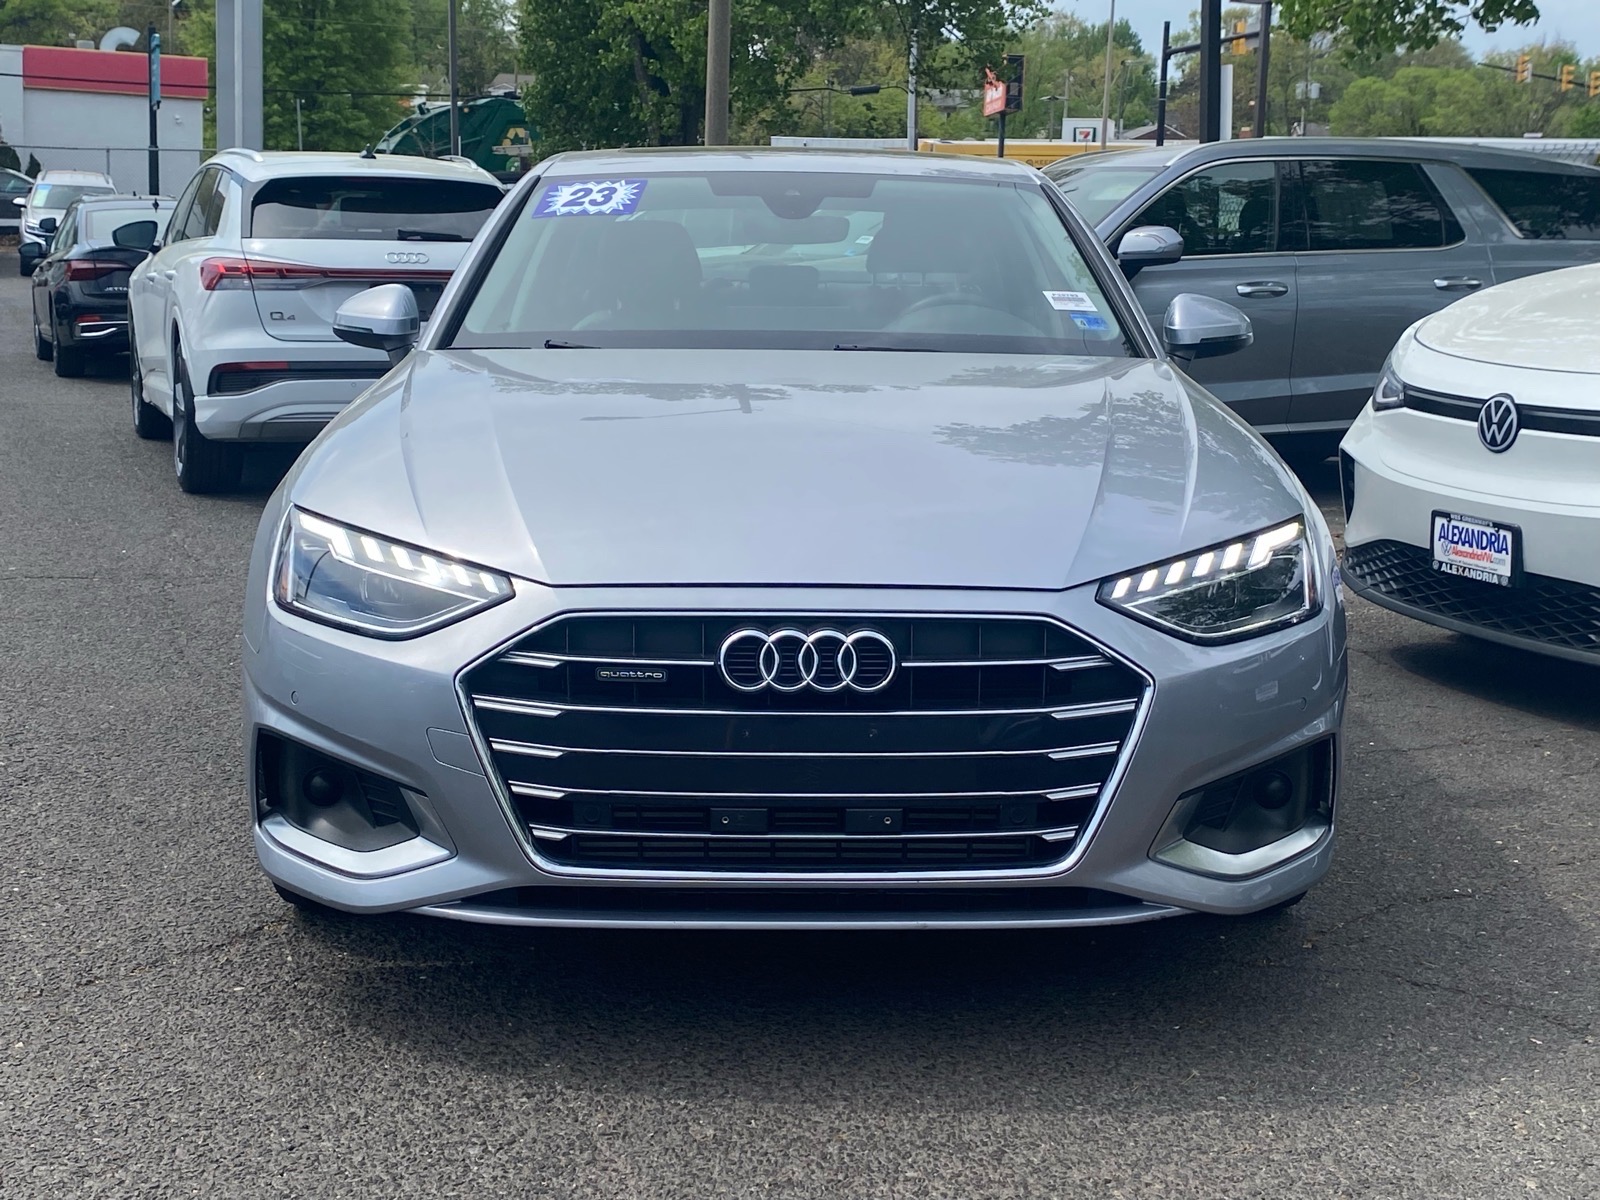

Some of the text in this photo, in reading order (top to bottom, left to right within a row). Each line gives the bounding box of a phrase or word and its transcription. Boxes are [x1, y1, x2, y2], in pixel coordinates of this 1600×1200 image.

[560, 186, 618, 207] 23
[270, 311, 296, 321] Q4
[1438, 522, 1509, 555] ALEXANDRIA
[1440, 562, 1499, 585] ALEXANDRIA
